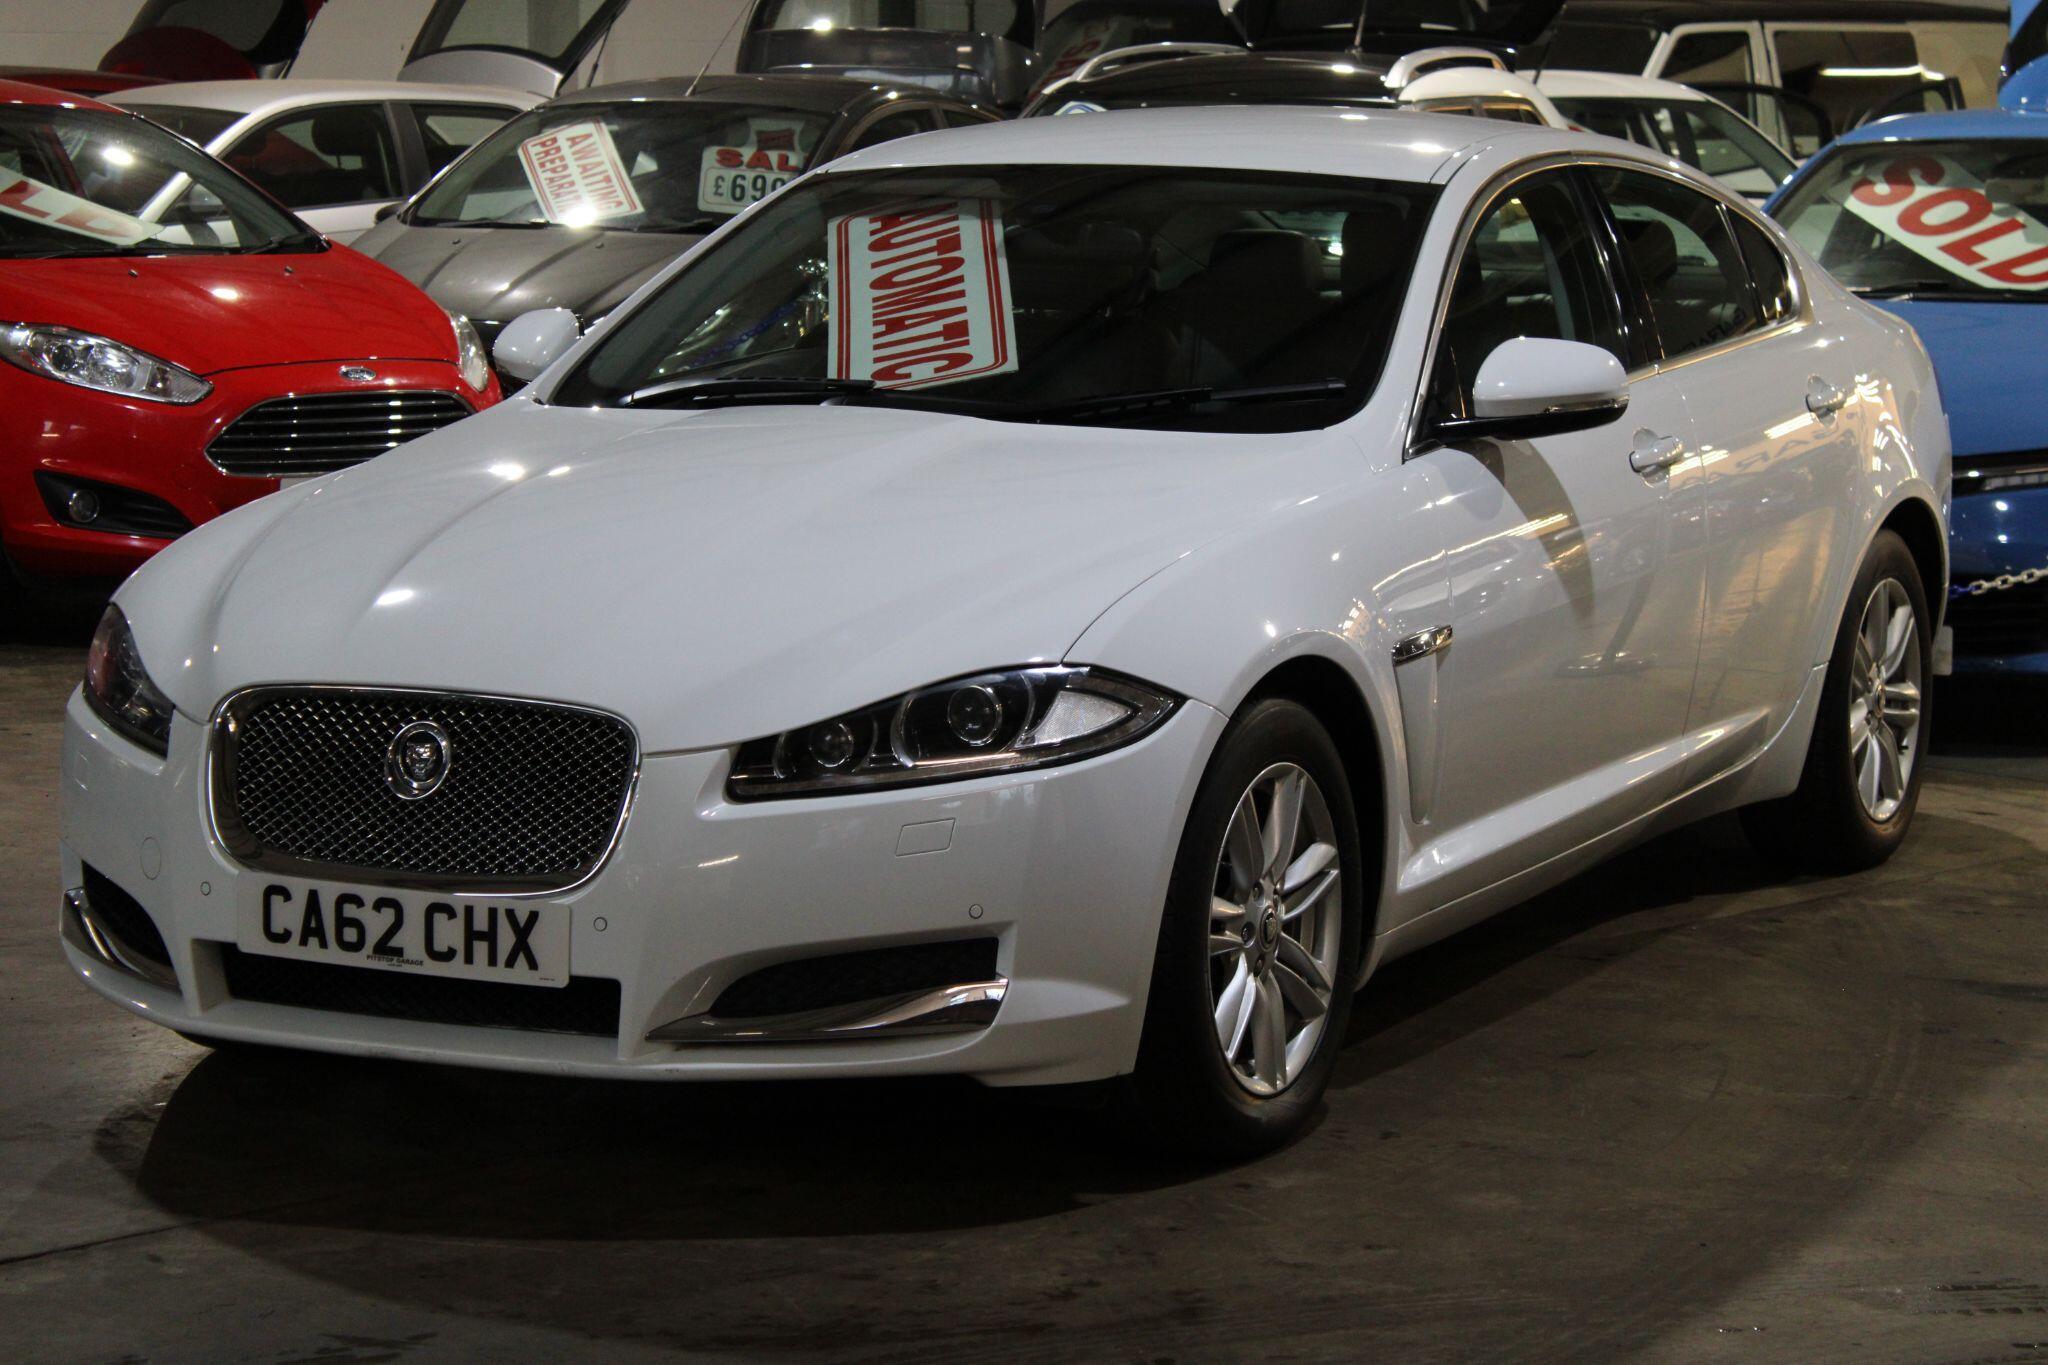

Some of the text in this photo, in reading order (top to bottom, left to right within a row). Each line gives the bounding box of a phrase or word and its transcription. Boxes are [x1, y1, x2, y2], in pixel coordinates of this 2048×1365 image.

[566, 132, 624, 209] AWAITING
[716, 148, 810, 173] SAL
[868, 201, 974, 381] AUTOMATIC
[262, 884, 540, 971] CA62 CHX
[396, 957, 425, 967] GARAGE
